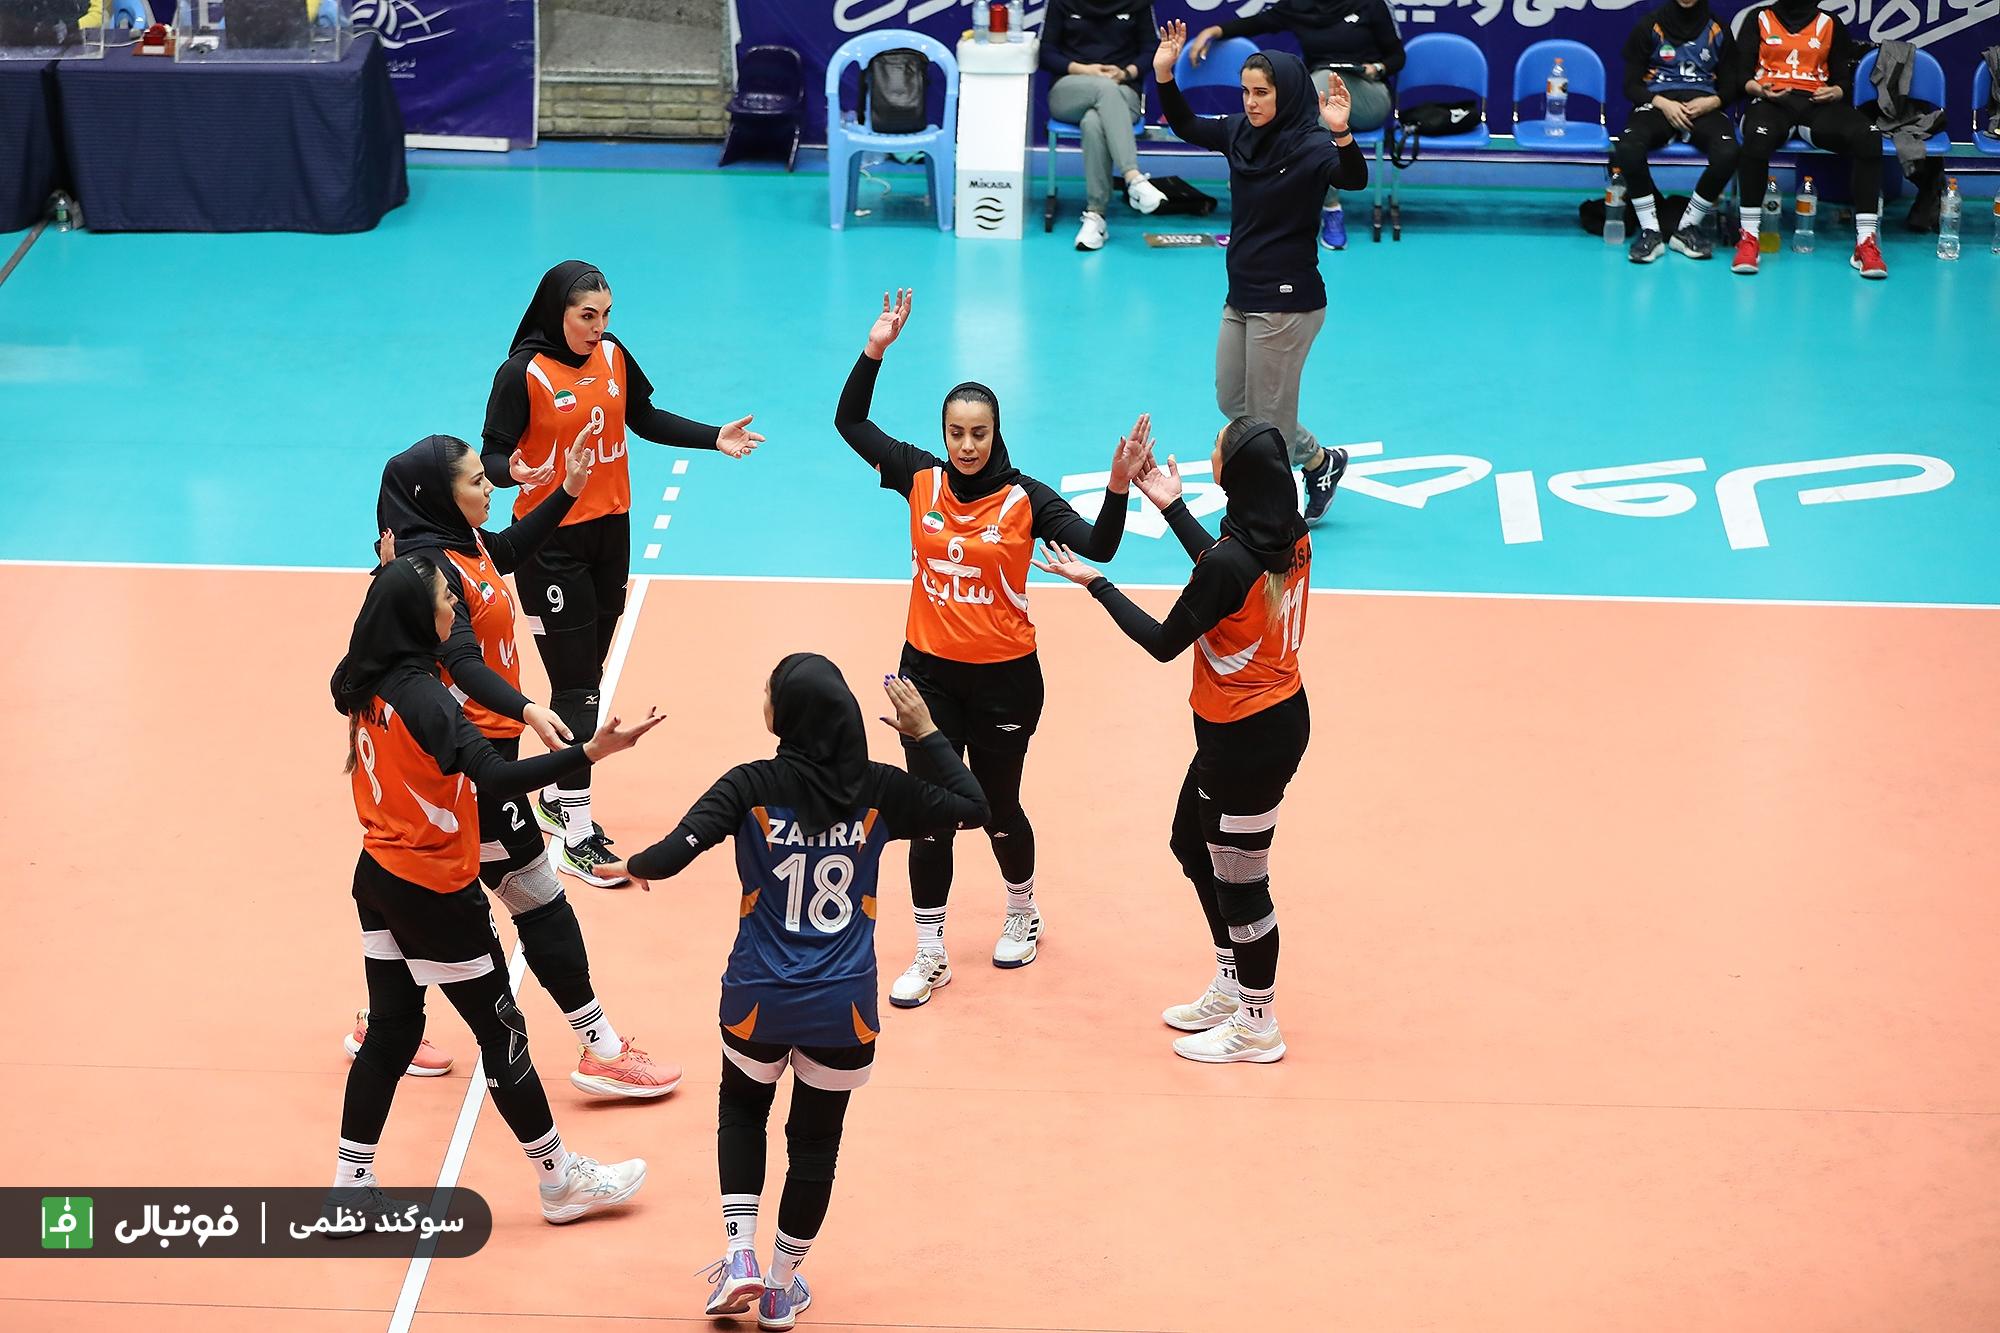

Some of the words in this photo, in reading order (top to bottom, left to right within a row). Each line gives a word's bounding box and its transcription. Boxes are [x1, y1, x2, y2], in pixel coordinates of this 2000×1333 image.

[1679, 60, 1697, 77] 12
[1785, 48, 1800, 70] 4
[591, 406, 605, 435] 9
[947, 536, 966, 563] 6
[547, 584, 564, 613] 9
[1279, 576, 1305, 661] 11
[502, 801, 526, 831] 2
[772, 853, 854, 933] 18
[1222, 967, 1236, 979] 11
[1246, 1006, 1263, 1018] 11
[586, 1029, 600, 1043] 2
[543, 1159, 554, 1171] 8
[726, 1222, 738, 1236] 18
